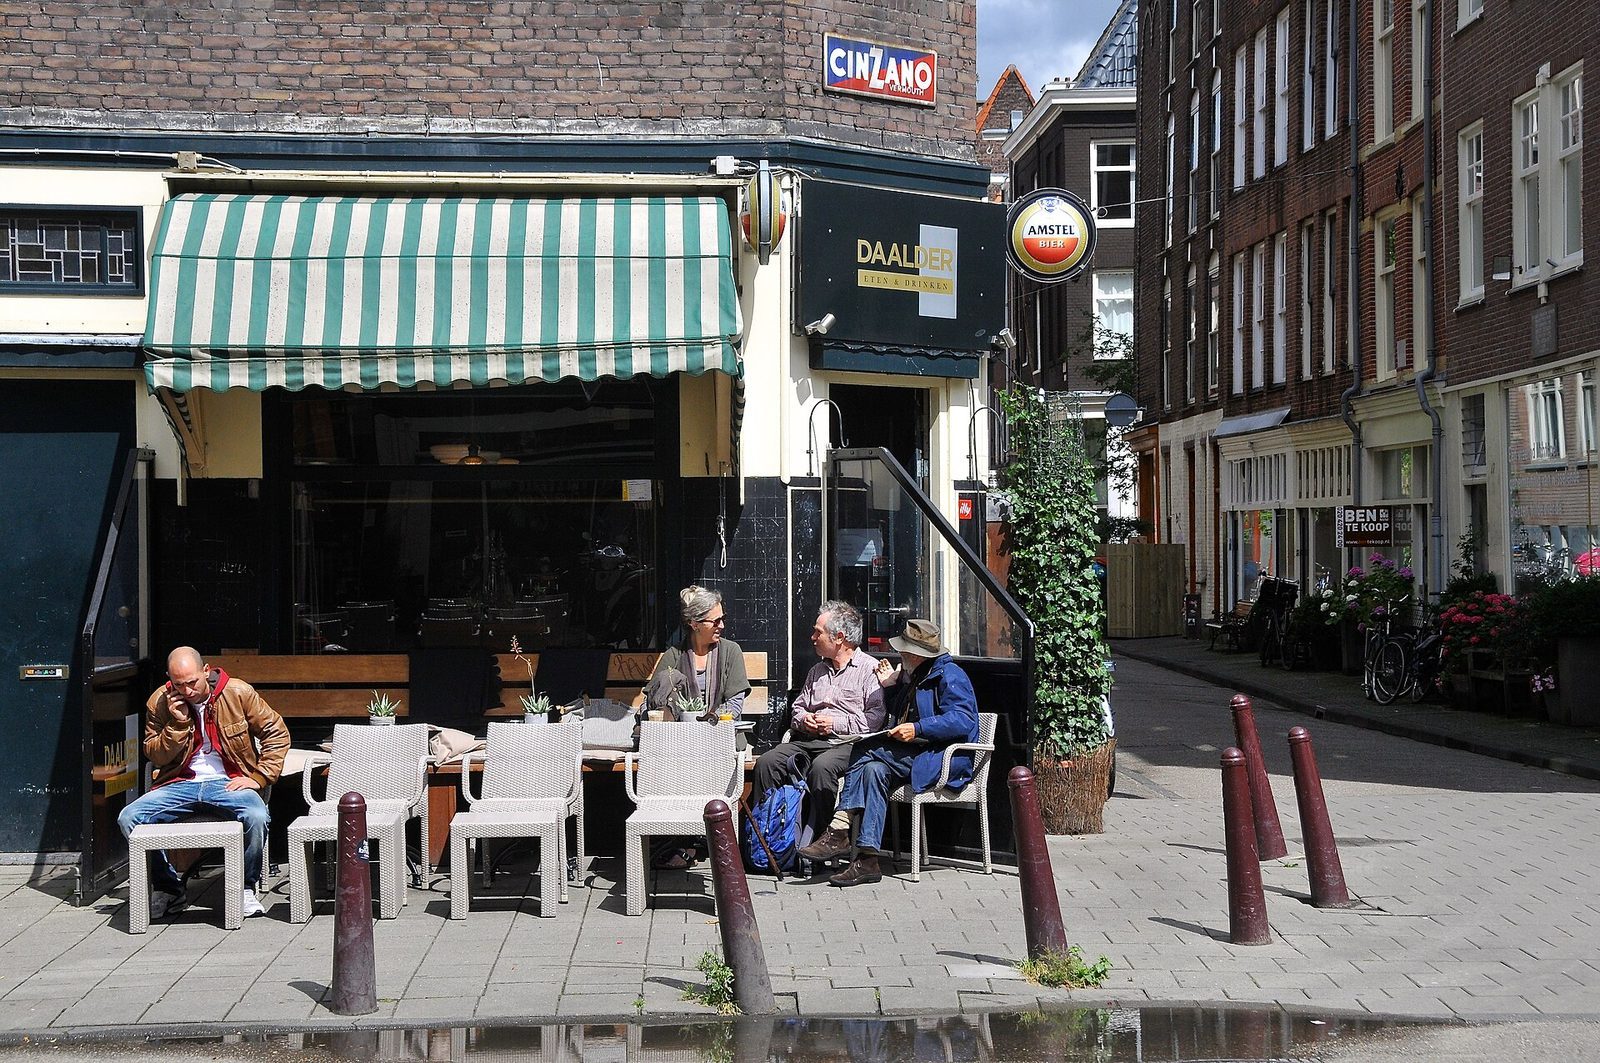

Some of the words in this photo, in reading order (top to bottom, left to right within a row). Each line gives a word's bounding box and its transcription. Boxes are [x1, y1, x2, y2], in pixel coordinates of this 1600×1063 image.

[829, 45, 933, 90] CINZANO
[889, 83, 925, 96] VERMOUTH
[1027, 224, 1075, 236] AMSTEL
[1039, 240, 1065, 249] BIER
[857, 238, 953, 273] DAALDER
[864, 275, 888, 285] ETEN
[904, 280, 949, 291] DRINKEN
[1344, 509, 1377, 522] BEN
[1345, 523, 1359, 532] TE
[1361, 522, 1390, 532] KOOP
[104, 738, 138, 771] DAAL
